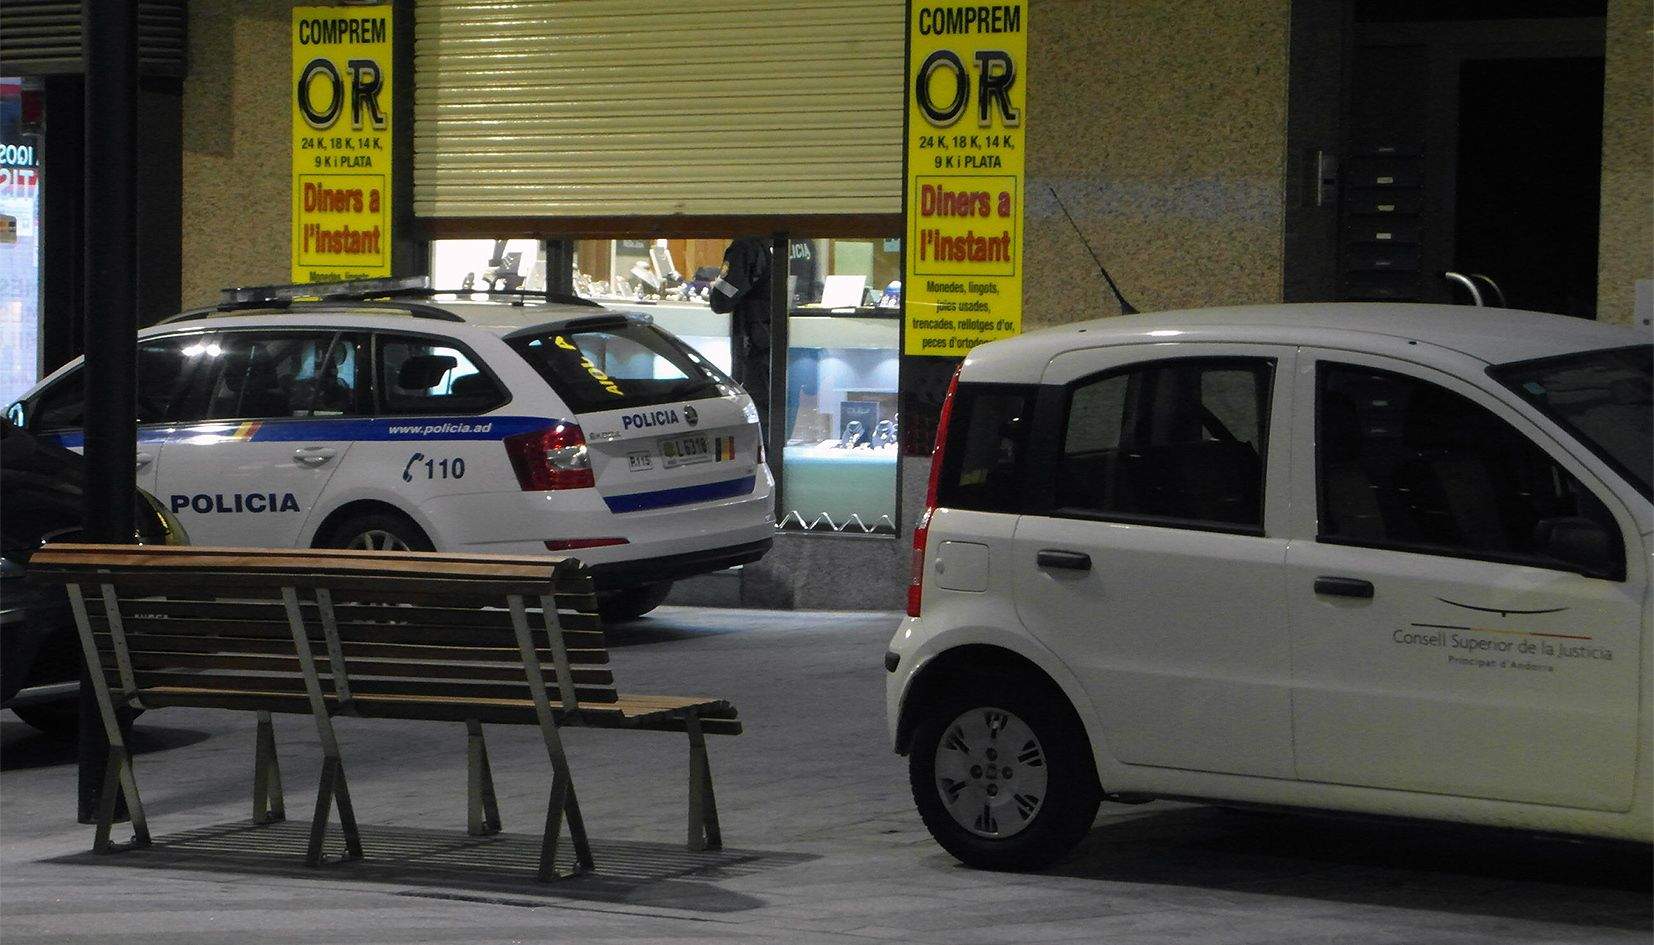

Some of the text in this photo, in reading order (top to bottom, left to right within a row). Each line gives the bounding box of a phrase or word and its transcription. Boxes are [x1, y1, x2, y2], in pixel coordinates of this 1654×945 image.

[919, 5, 1021, 36] COMPREM
[299, 18, 386, 46] COMPREM
[298, 57, 387, 131] OR
[916, 49, 1021, 128] OR
[301, 138, 383, 151] 24 K, 18 K, 14 K,
[919, 135, 1015, 150] 24 K, 18 K, 14 K,
[315, 156, 322, 168] 9
[324, 156, 331, 167] K
[340, 156, 372, 168] PLATA
[935, 155, 943, 168] 9
[946, 155, 954, 168] K
[964, 156, 1002, 168] PLATA
[304, 182, 380, 213] Diners a
[921, 184, 1011, 218] Diners a
[303, 223, 380, 254] l'instant
[920, 229, 1011, 262] l'instant
[926, 280, 1000, 296] Monedes, lingots,
[959, 301, 991, 313] usades,
[912, 317, 956, 331] trencades,
[388, 423, 493, 436] www.policia.ad
[621, 410, 679, 430] POLICIA
[425, 457, 465, 480] 110
[170, 493, 300, 514] POLICIA
[1393, 629, 1446, 648] Consell
[1451, 633, 1513, 653] Superior
[1518, 640, 1536, 655] de
